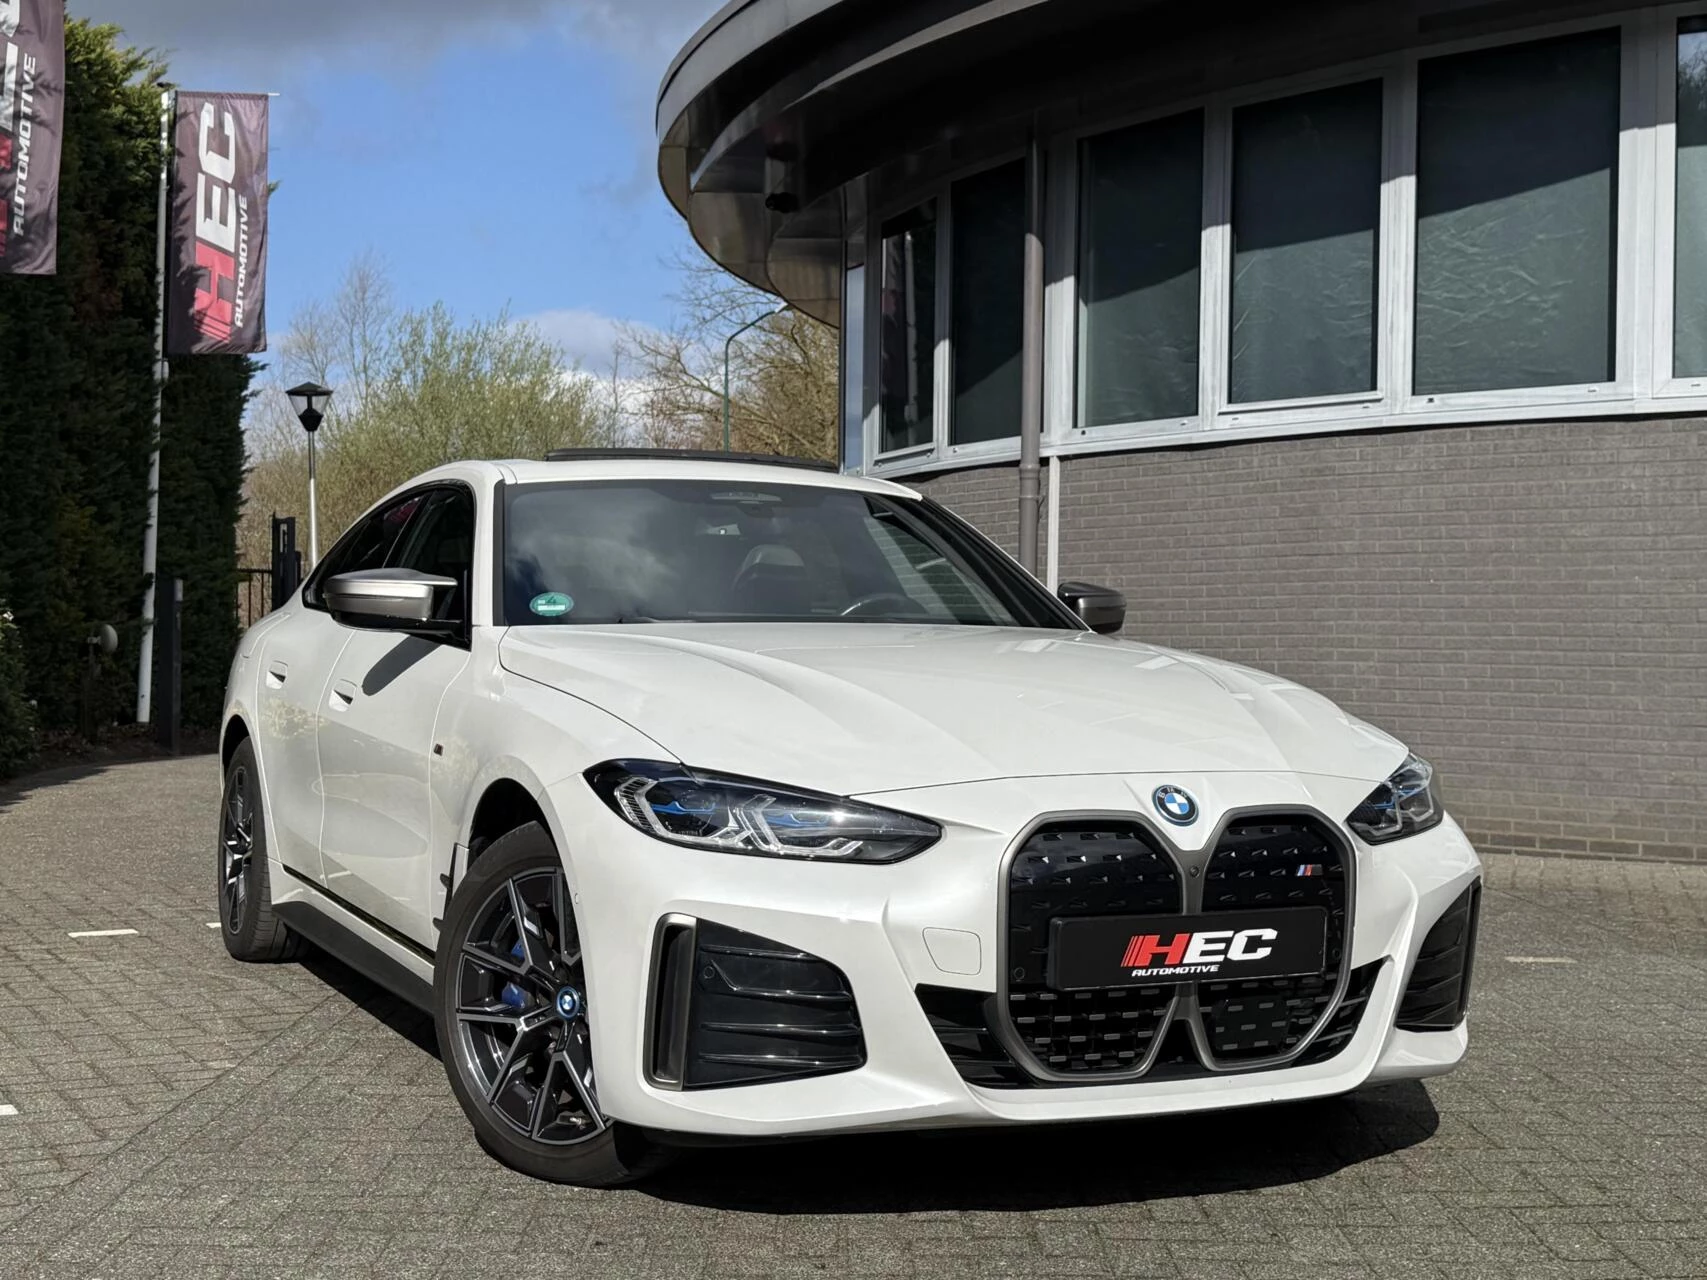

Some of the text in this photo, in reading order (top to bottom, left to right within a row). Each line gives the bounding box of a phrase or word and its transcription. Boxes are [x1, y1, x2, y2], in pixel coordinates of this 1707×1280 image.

[13, 53, 36, 236] AUTOMOTIVE
[193, 102, 238, 344] HEC
[234, 194, 248, 328] AUTOMOTIVE
[1120, 928, 1278, 967] HEC
[1131, 964, 1220, 977] AUTOMOTIVE
